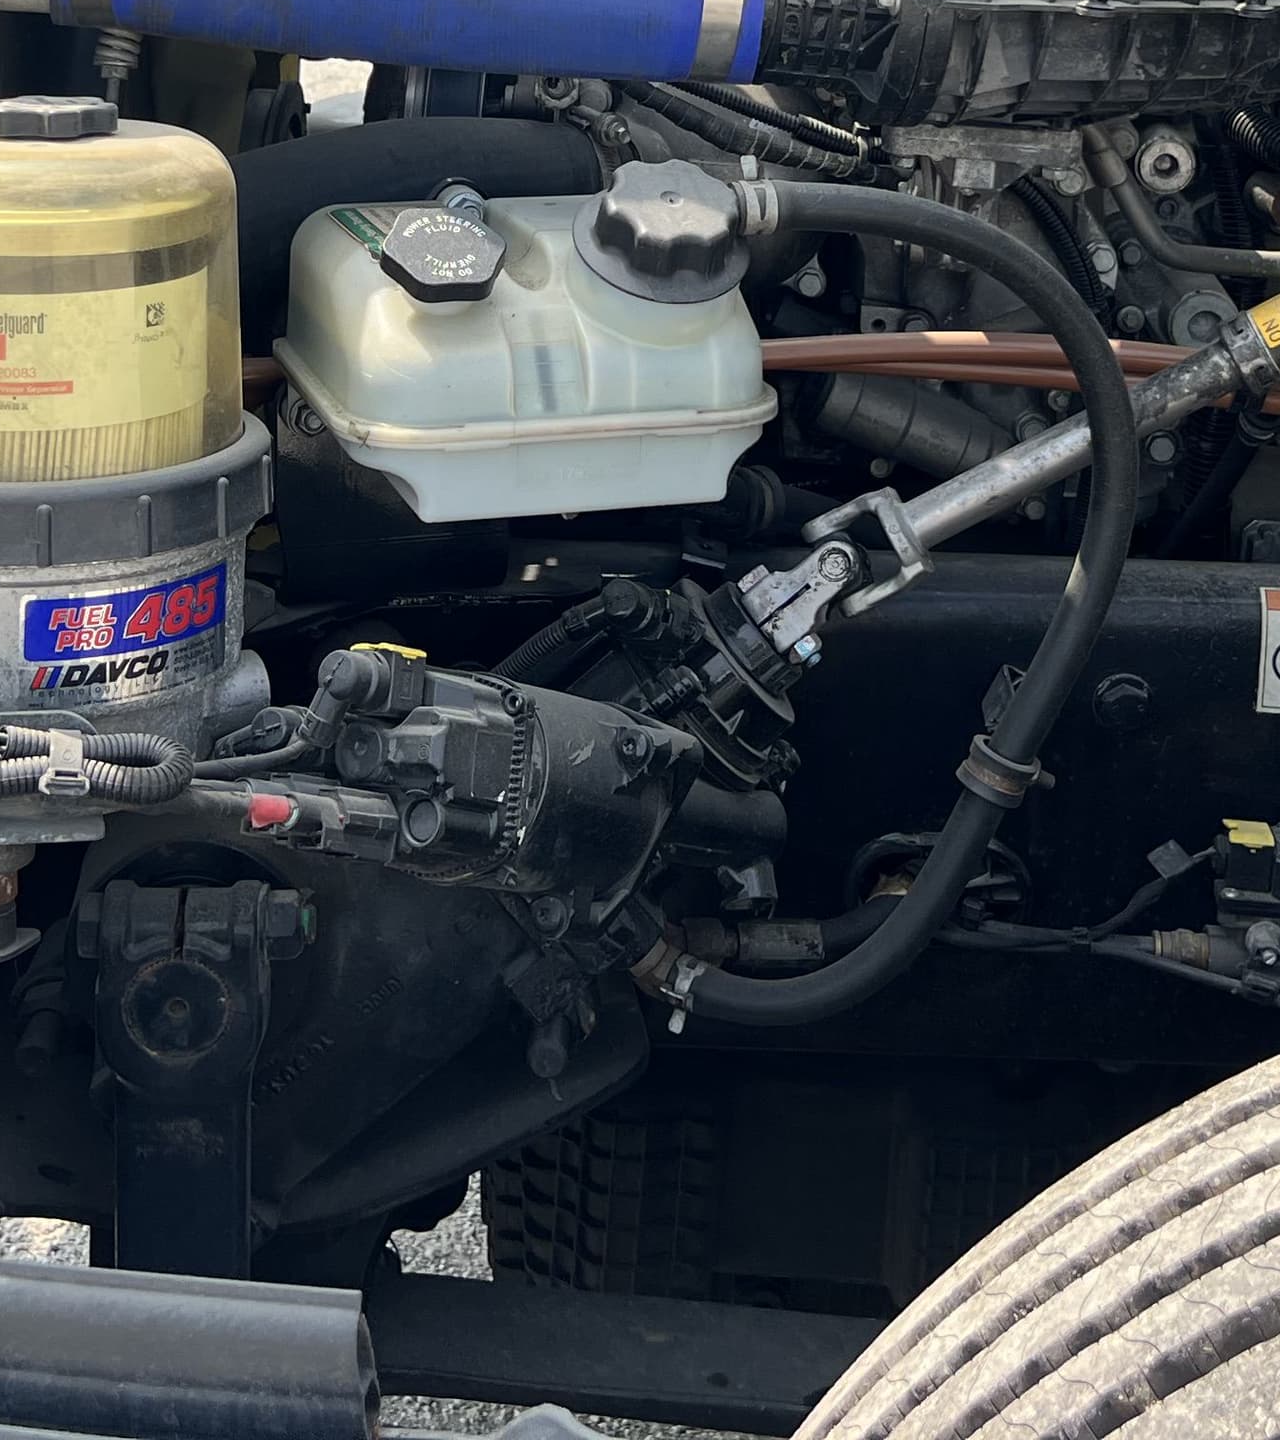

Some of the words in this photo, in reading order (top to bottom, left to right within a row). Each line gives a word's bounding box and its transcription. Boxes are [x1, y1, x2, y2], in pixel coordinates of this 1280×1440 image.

[402, 216, 432, 238] POWER
[435, 215, 487, 238] STEERING
[424, 224, 461, 234] FLUID
[424, 253, 476, 269] OVERFILL
[431, 269, 454, 278] NOT
[458, 267, 473, 277] DO
[48, 604, 117, 631] FUEL
[122, 575, 218, 644] 485
[55, 626, 115, 652] PRO
[60, 650, 169, 689] DAVCO
[30, 683, 119, 698] Technology
